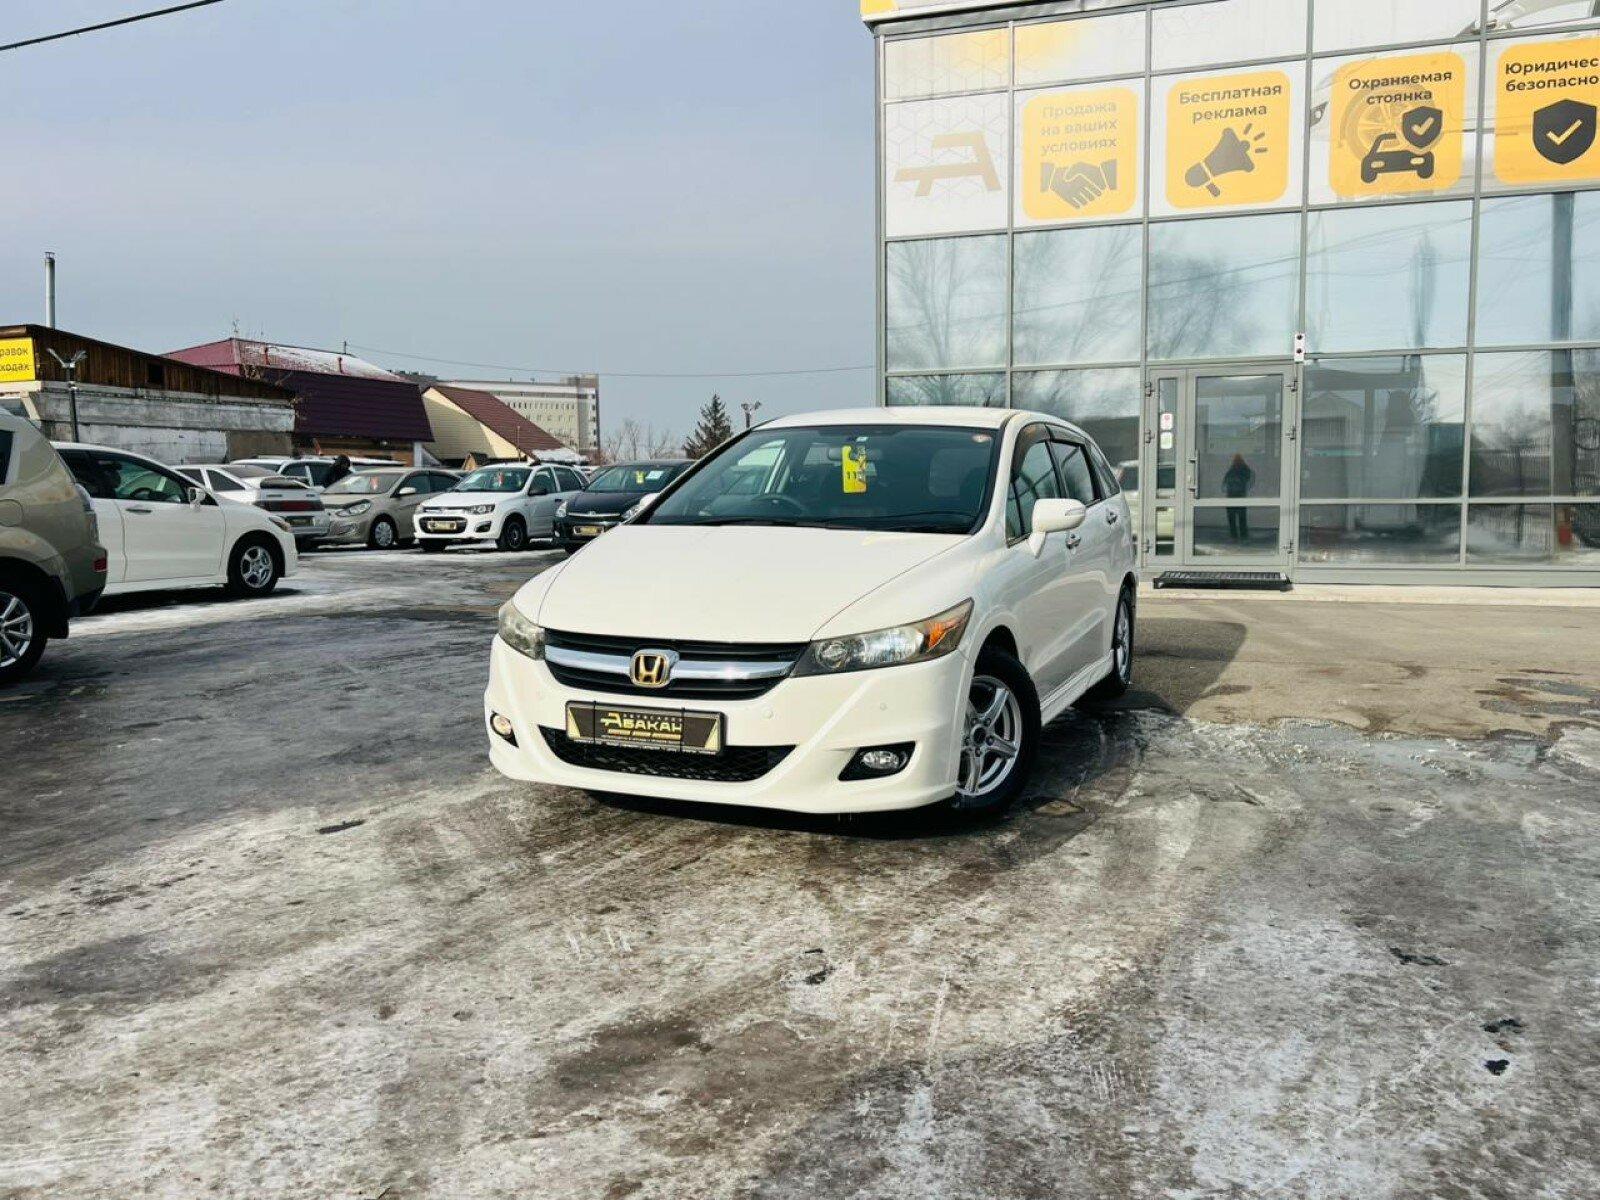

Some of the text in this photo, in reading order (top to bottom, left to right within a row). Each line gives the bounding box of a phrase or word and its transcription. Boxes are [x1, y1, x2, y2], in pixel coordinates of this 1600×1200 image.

[1505, 57, 1600, 76] Юридичес
[1349, 70, 1453, 91] Охраняемая
[1505, 75, 1600, 92] безопасно
[1180, 84, 1283, 104] Бесплатная
[1366, 89, 1433, 106] стоянка
[1042, 102, 1117, 119] Продажа
[1192, 105, 1268, 124] реклама
[1040, 119, 1118, 136] на ваших
[1041, 138, 1118, 156] условиях
